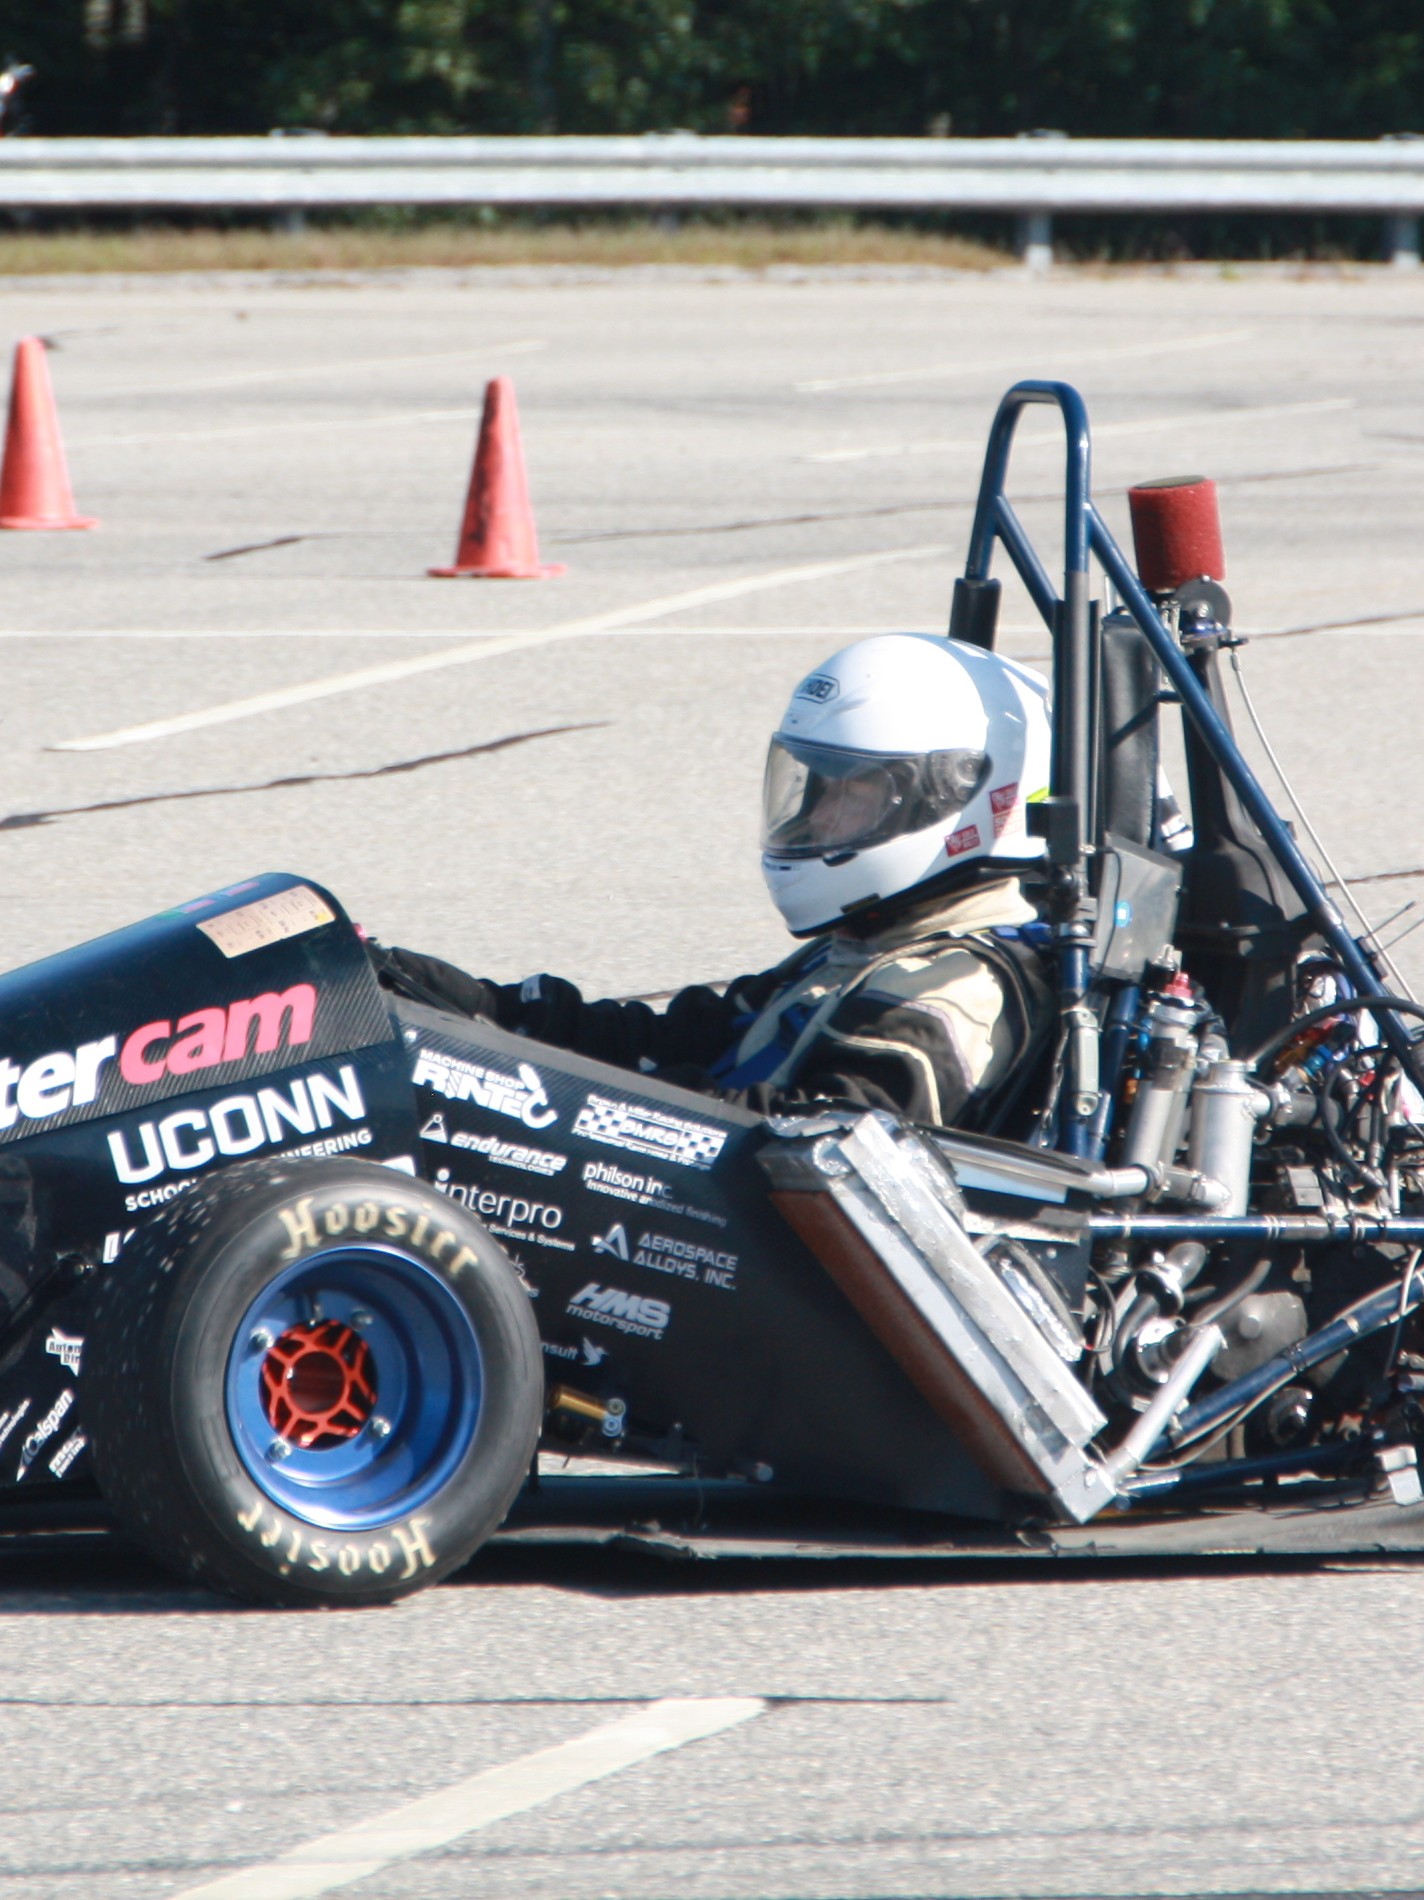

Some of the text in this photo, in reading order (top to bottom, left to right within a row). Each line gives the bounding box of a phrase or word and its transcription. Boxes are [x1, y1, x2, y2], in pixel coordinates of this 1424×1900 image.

[419, 1048, 526, 1091] MACHINE SHOP
[106, 1065, 366, 1184] UCONN
[450, 1130, 568, 1172] endurance
[434, 1167, 564, 1229] interpro
[582, 1162, 644, 1193] philson
[586, 1178, 639, 1204] Innovative
[278, 1197, 479, 1280] Hoosier
[487, 1223, 527, 1242] Services
[537, 1233, 576, 1252] Systems
[638, 1232, 739, 1272] AEROSPACE
[704, 1268, 737, 1291] INC.
[565, 1303, 665, 1341] motorsport
[569, 1282, 672, 1329] HMS
[25, 1387, 76, 1458] Calspan
[236, 1500, 438, 1580] Hoosier
